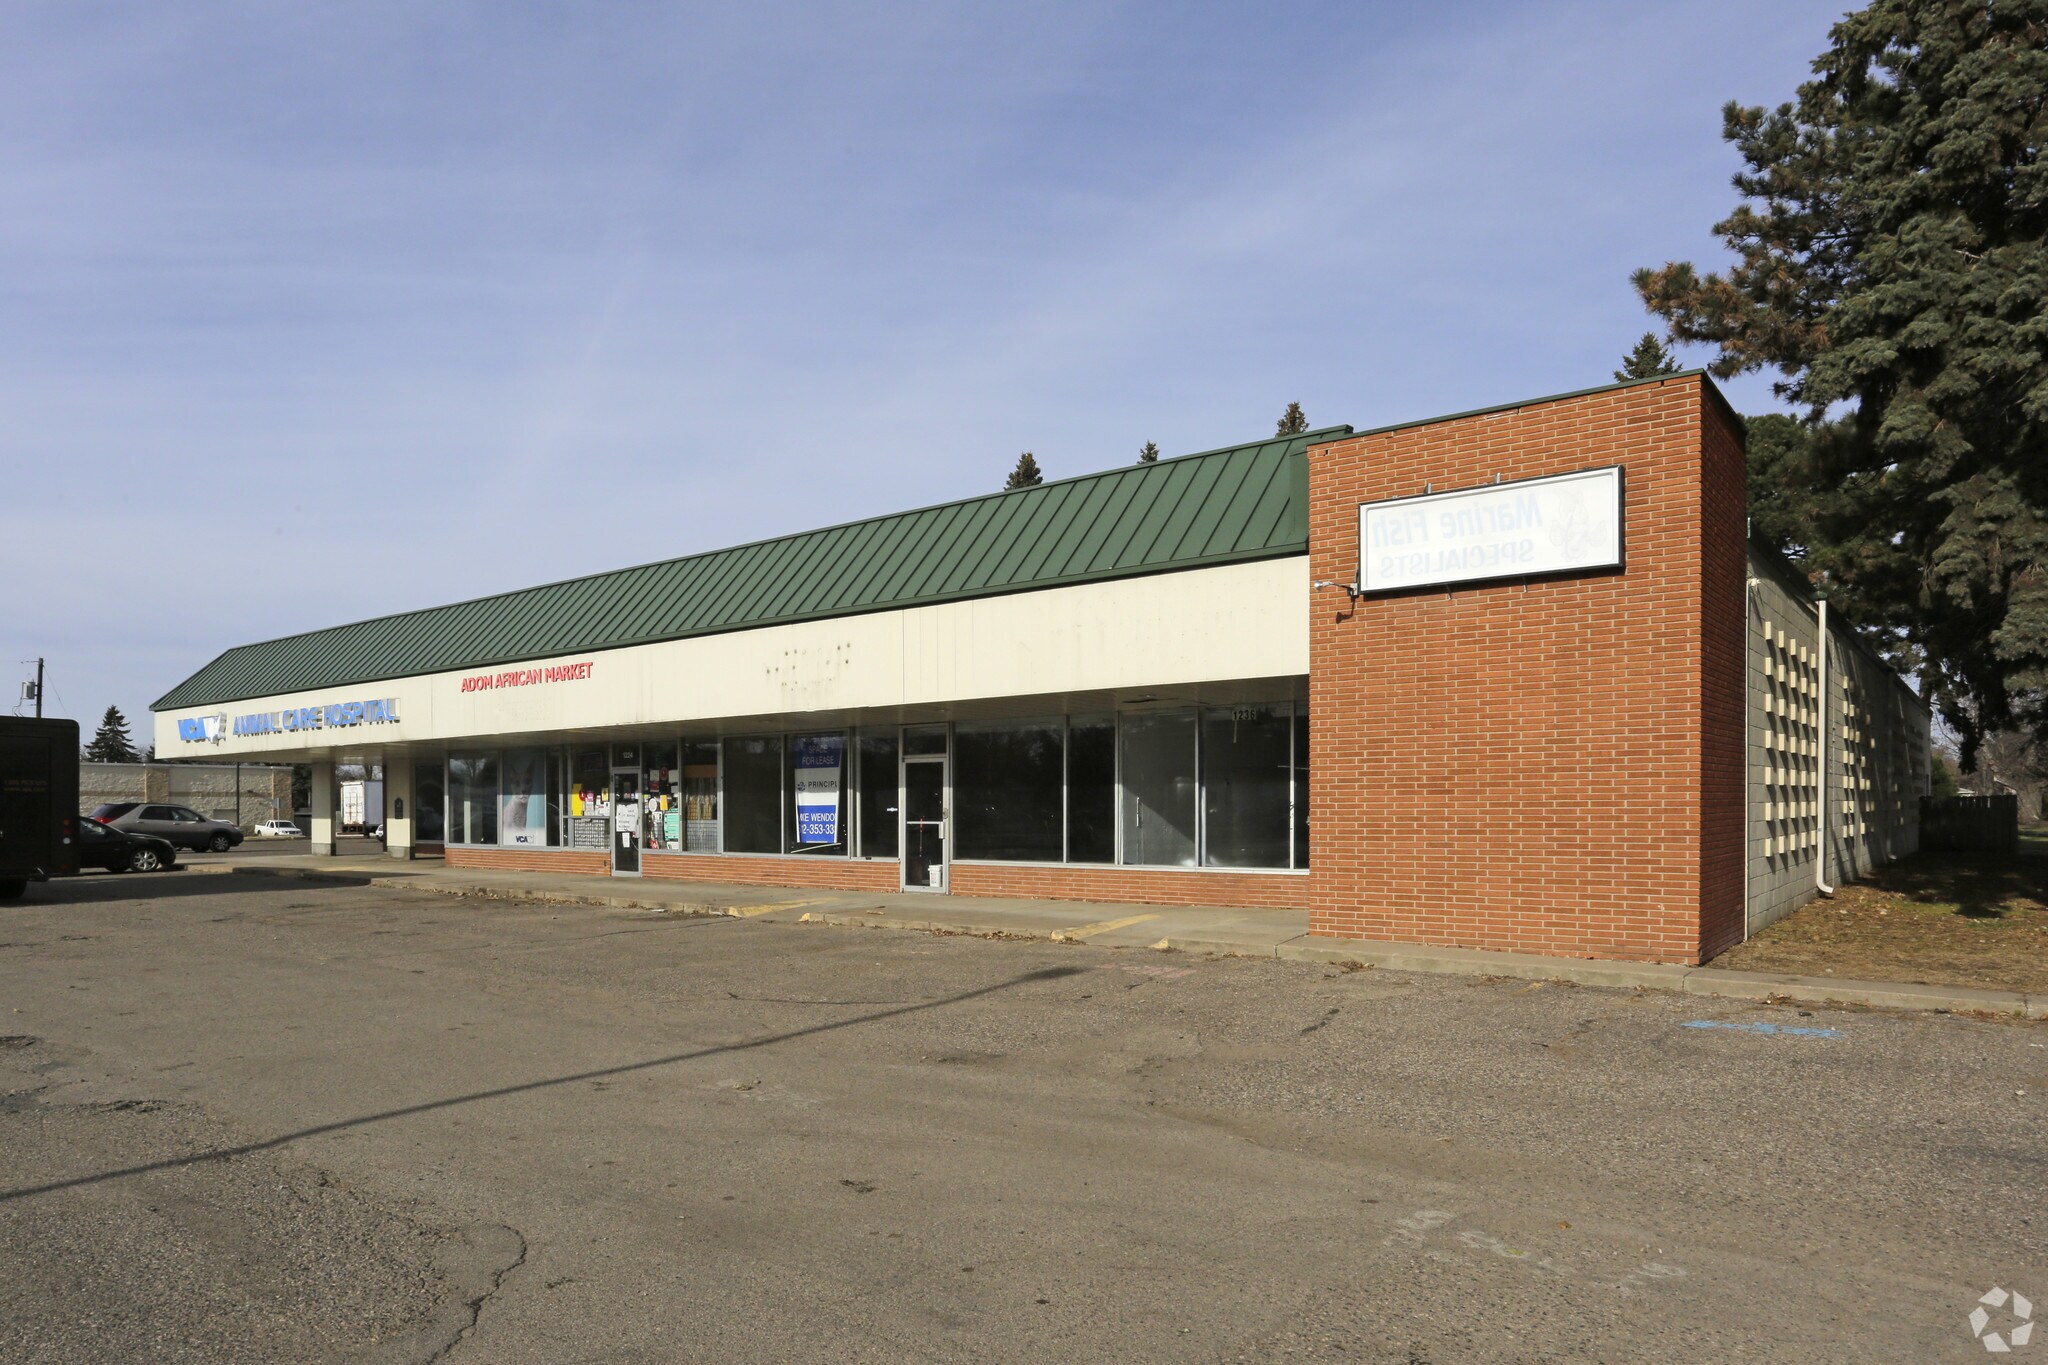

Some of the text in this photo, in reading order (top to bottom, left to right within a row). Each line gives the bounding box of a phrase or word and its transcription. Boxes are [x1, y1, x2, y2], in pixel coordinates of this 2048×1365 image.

[461, 661, 593, 693] ADOM AFRICAN MARKET
[232, 712, 282, 736] ANIMAL
[282, 707, 320, 731] CARE
[323, 698, 399, 727] HOSPITAL
[1233, 709, 1256, 720] 1236
[801, 755, 835, 766] FOR LEASE
[515, 835, 529, 843] VCA
